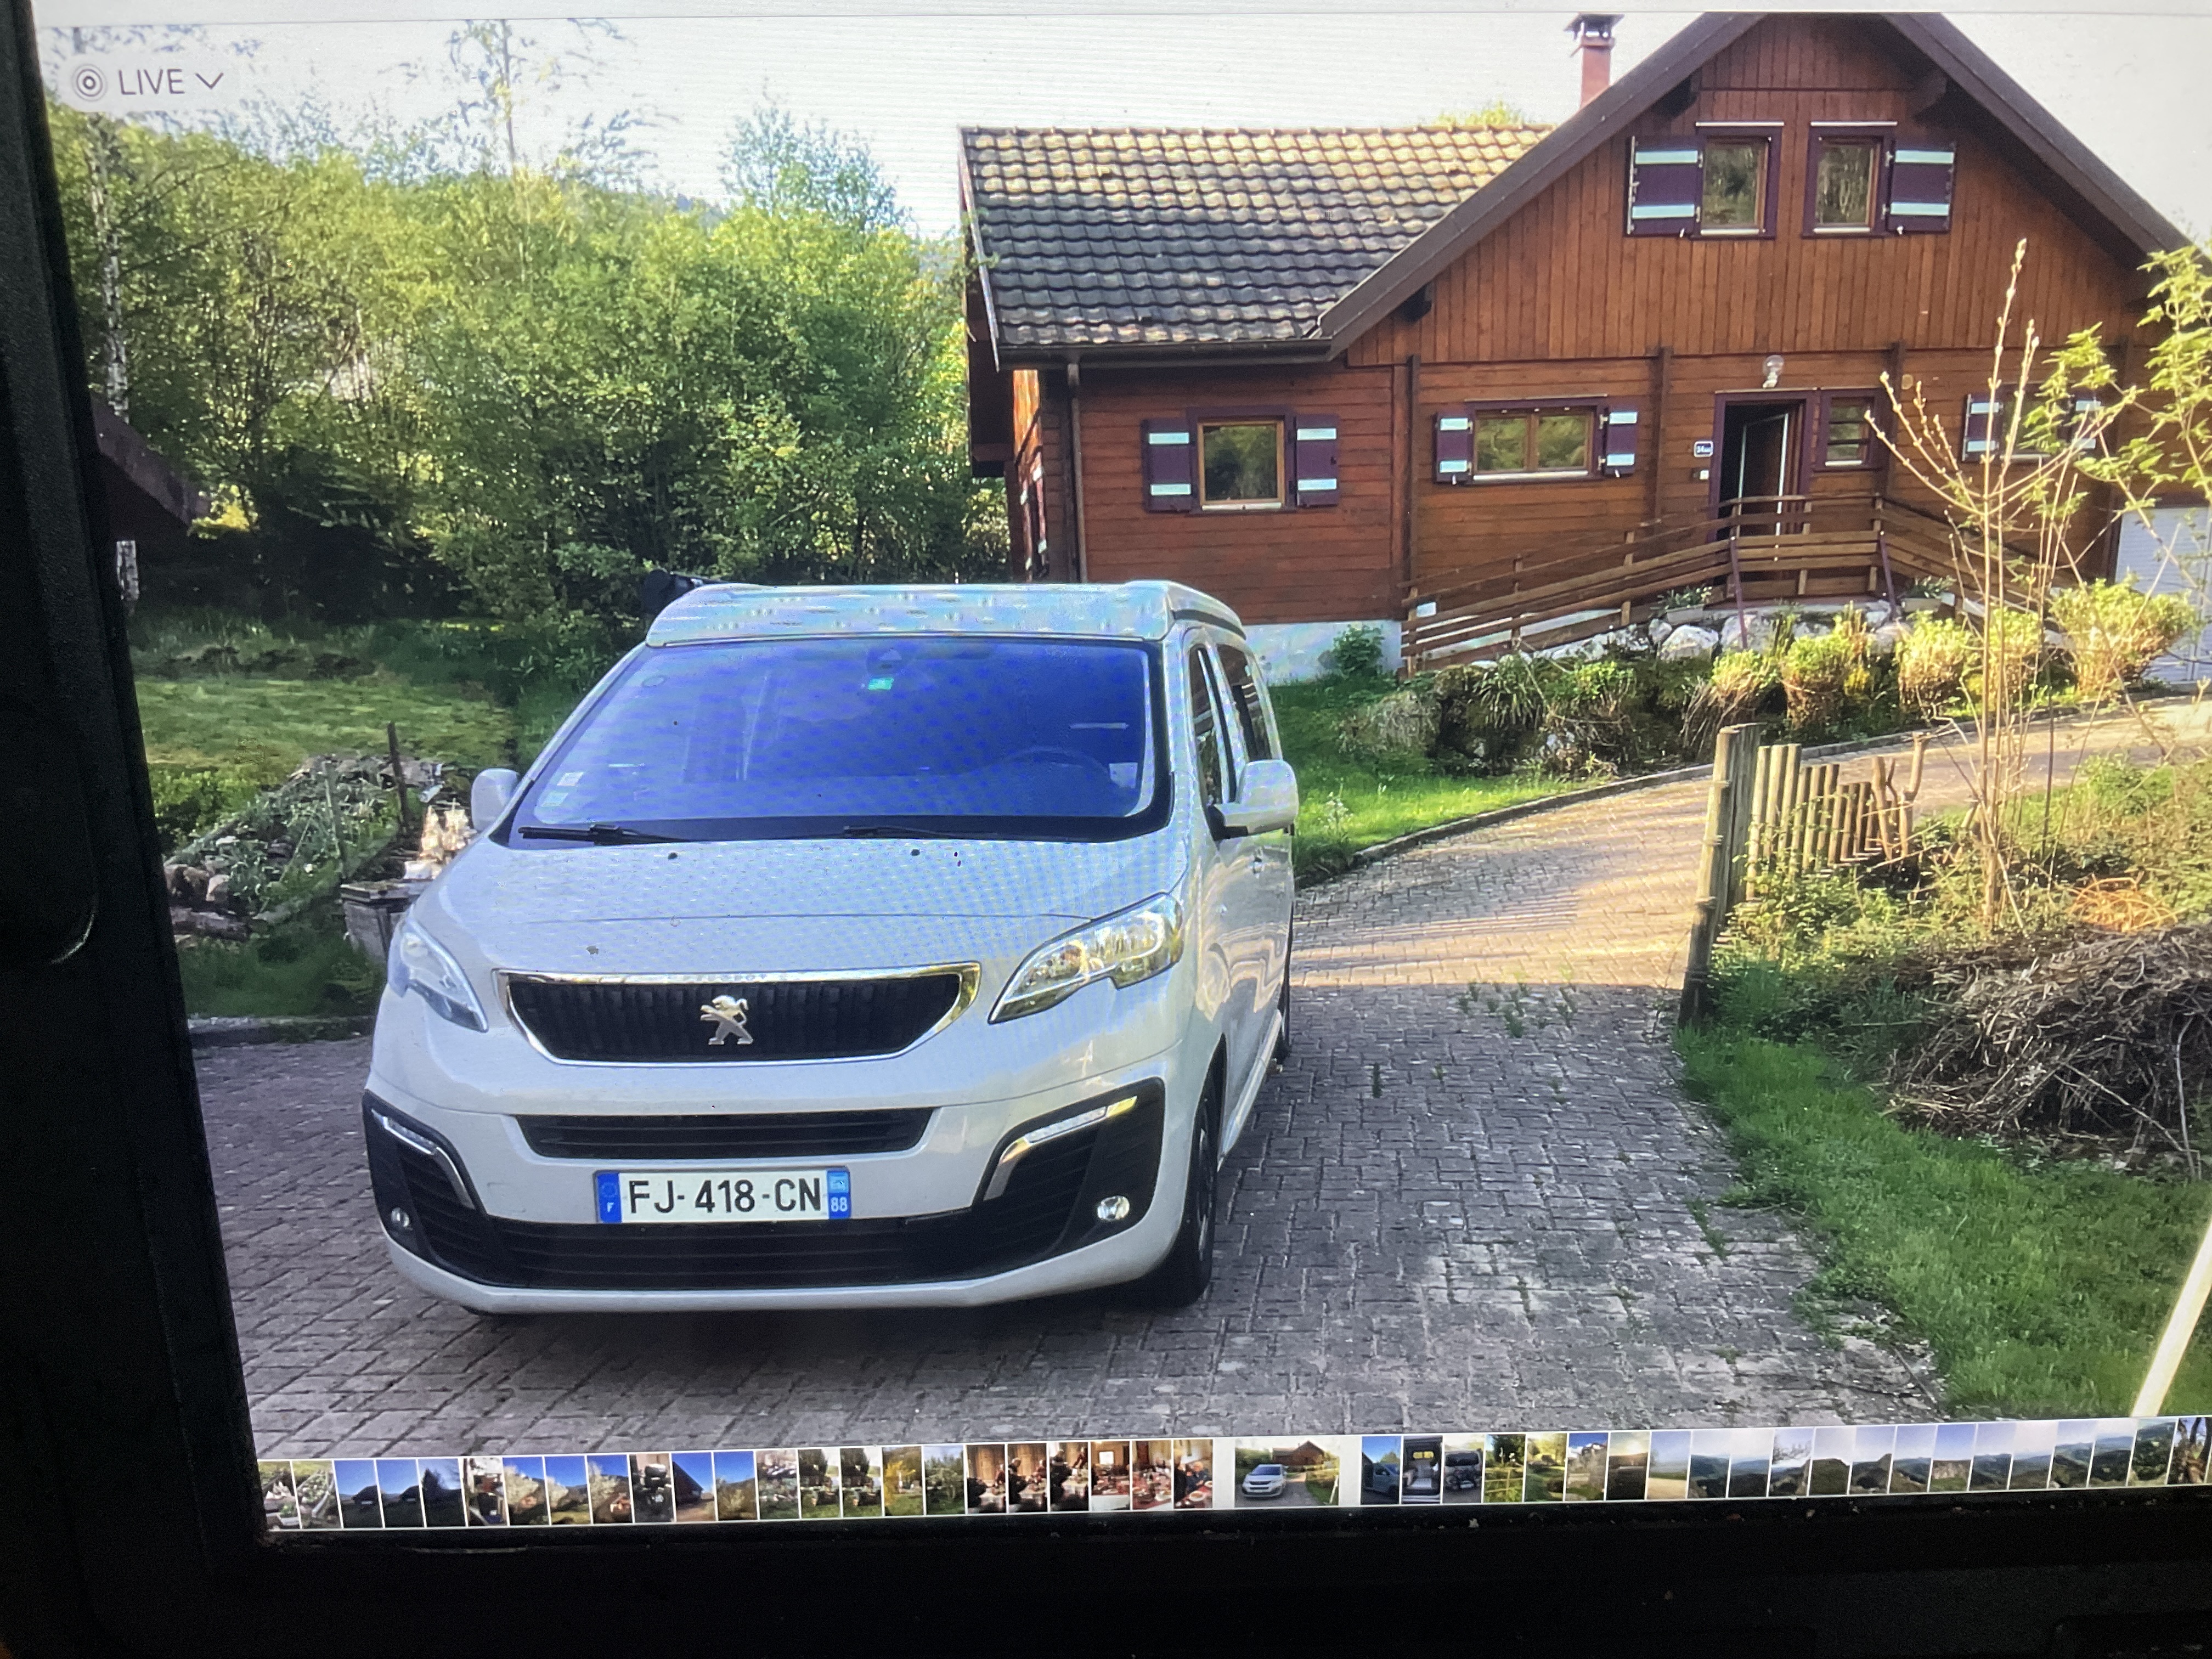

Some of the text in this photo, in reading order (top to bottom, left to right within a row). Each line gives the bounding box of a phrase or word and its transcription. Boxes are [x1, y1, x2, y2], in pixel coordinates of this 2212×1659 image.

[119, 69, 185, 94] LIVE
[628, 1178, 821, 1214] FJ-418-CN
[831, 1197, 848, 1212] 88
